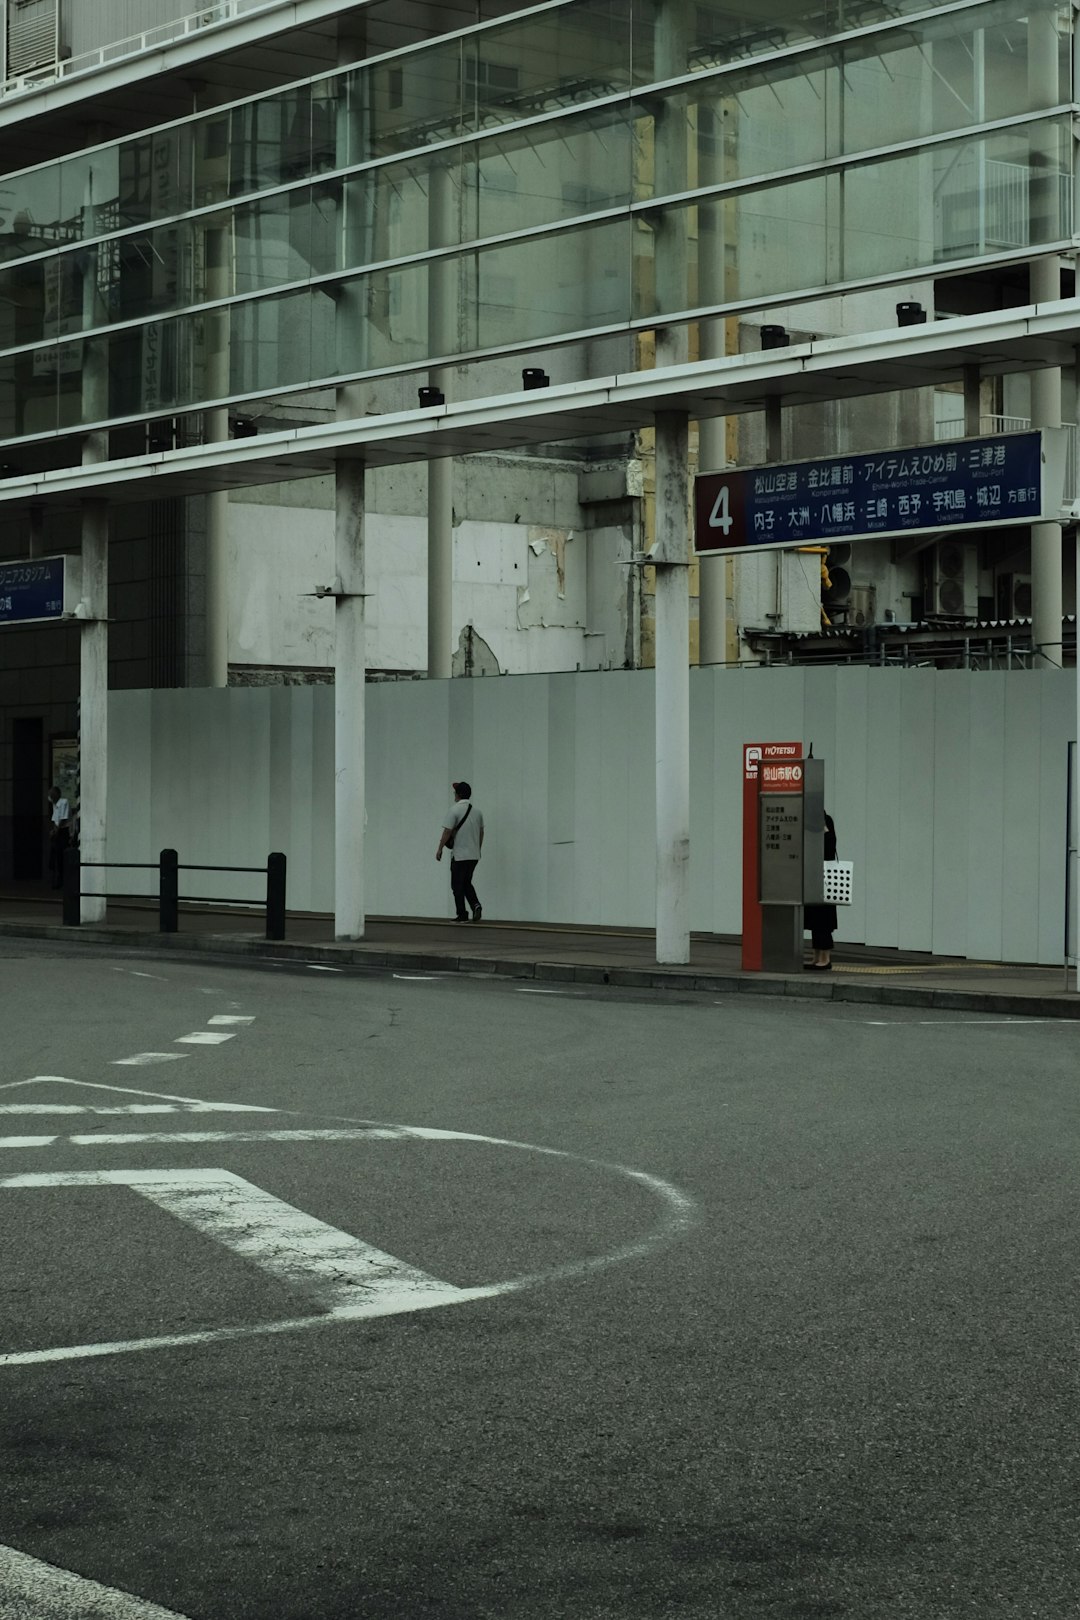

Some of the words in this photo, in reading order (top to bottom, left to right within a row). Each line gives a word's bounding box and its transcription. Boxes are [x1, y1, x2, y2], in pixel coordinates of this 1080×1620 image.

[1008, 487, 1037, 503] 方面行
[708, 486, 733, 536] 4
[764, 746, 796, 756] IYOTETSU
